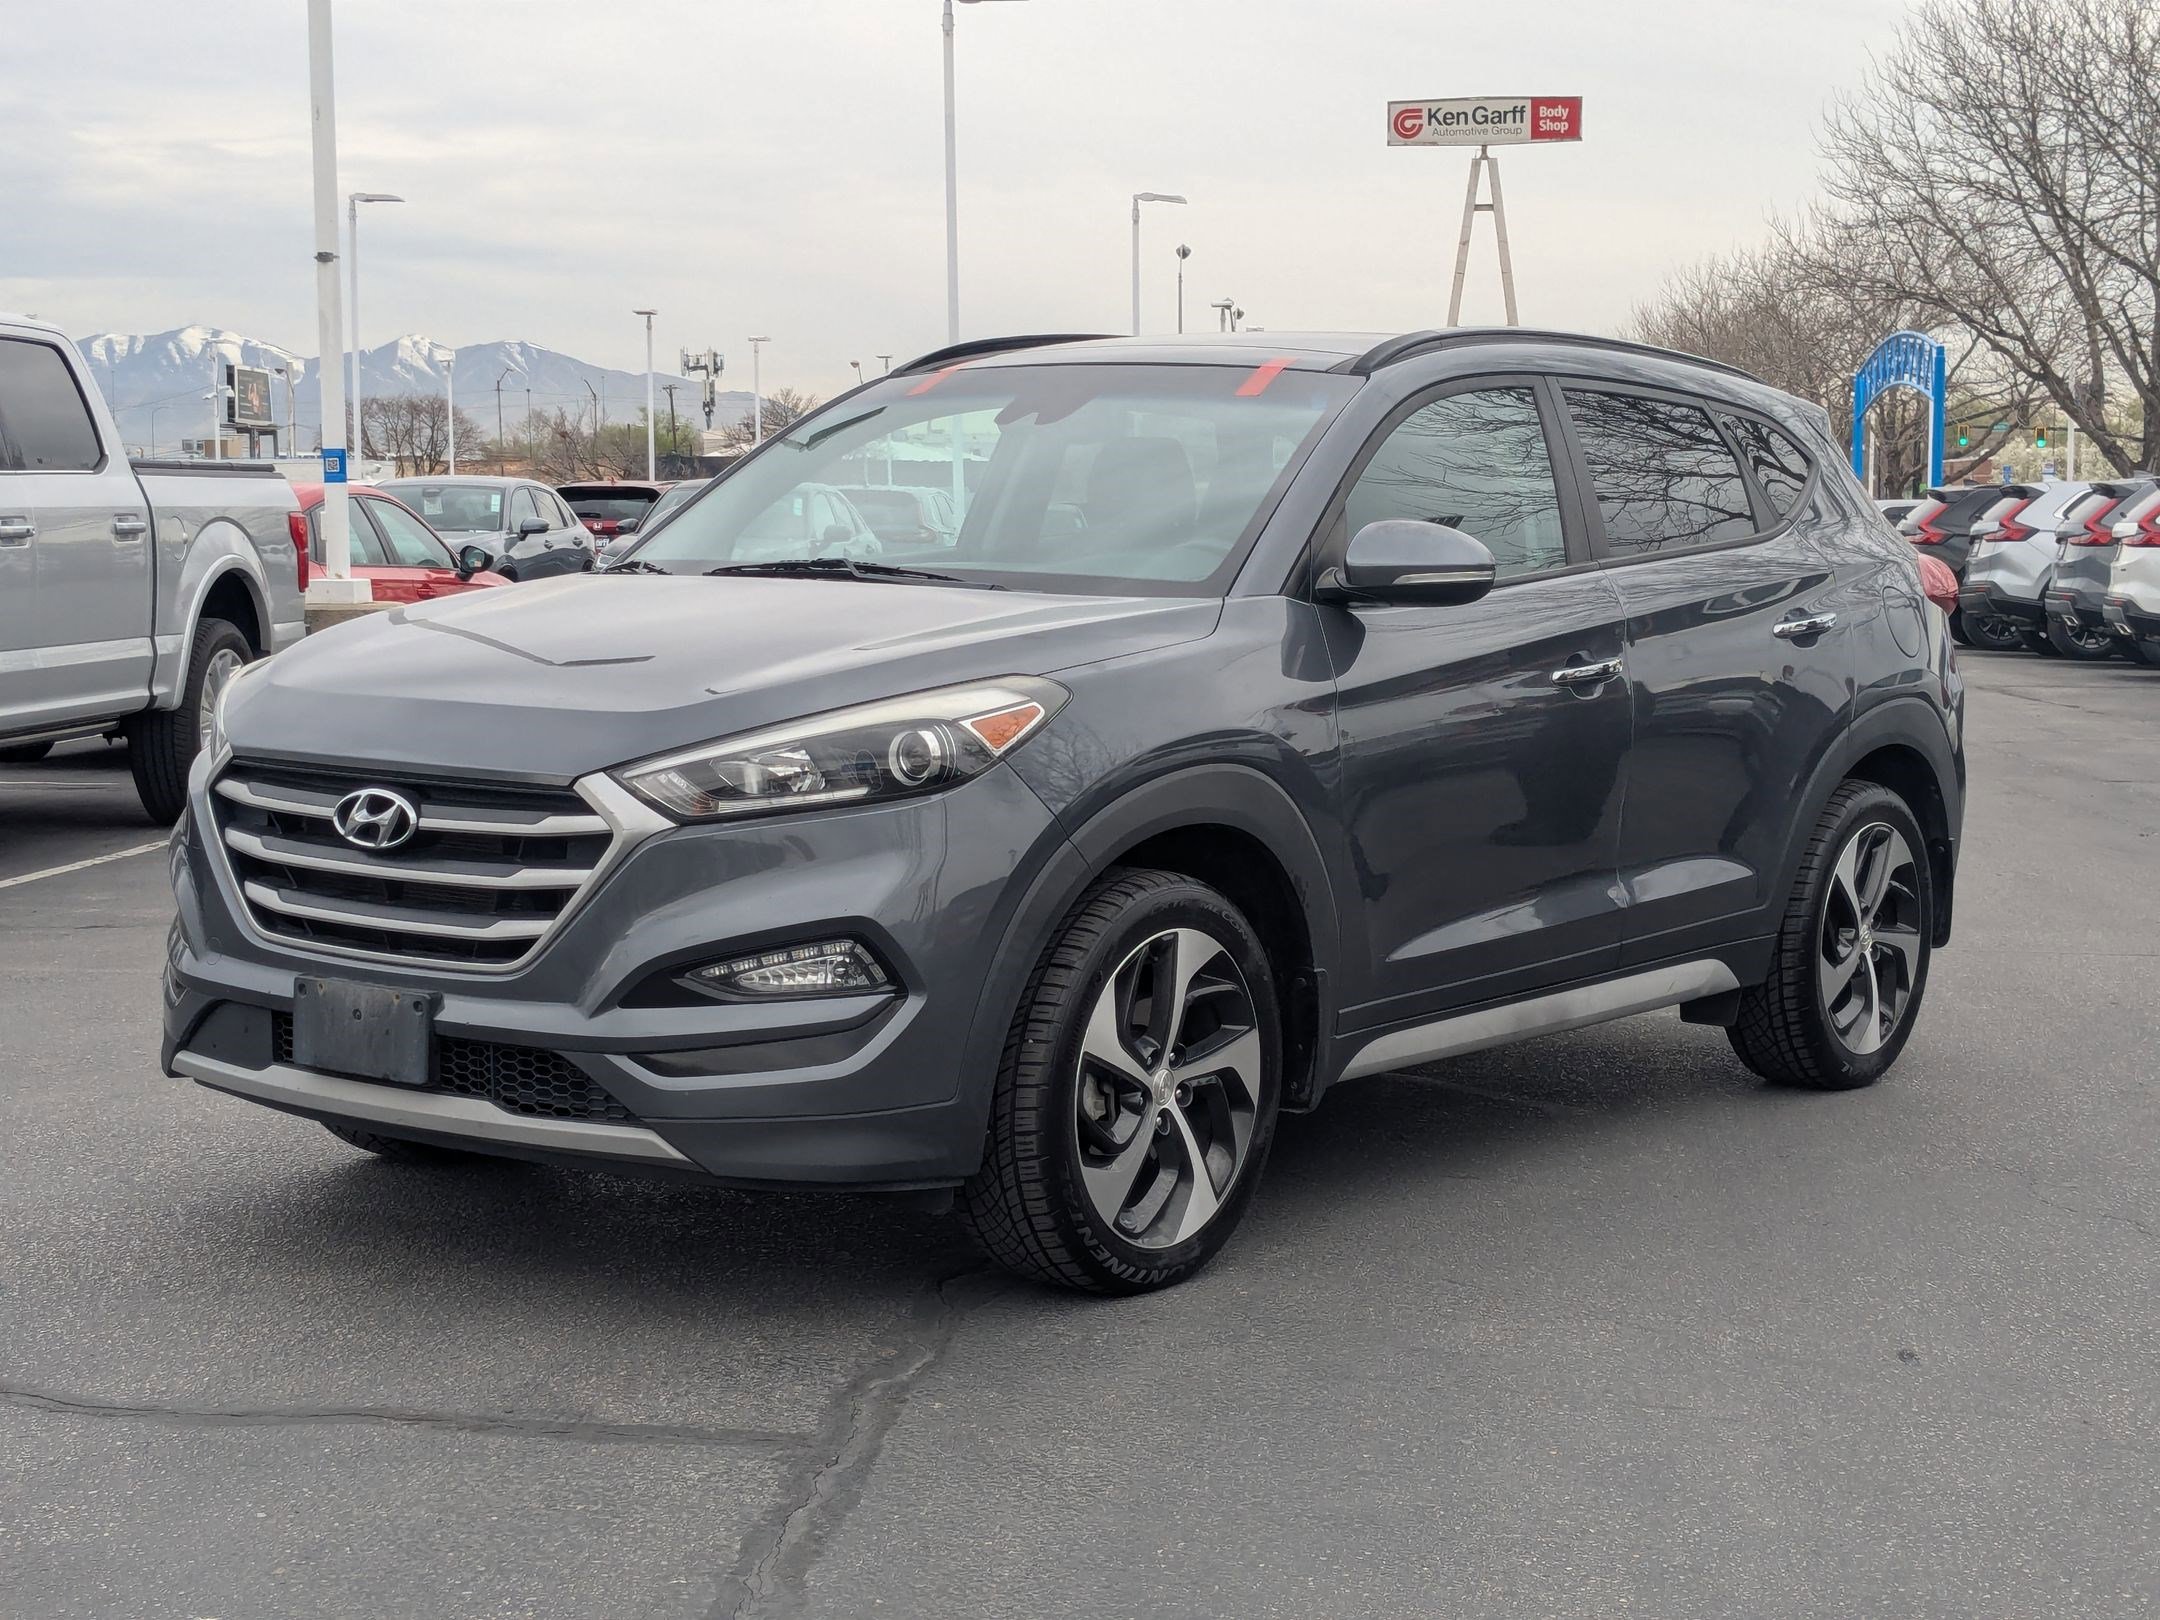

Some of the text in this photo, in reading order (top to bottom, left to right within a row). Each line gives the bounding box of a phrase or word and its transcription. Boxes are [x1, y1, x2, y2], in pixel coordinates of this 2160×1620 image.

[1427, 105, 1526, 126] Ken Garff
[1539, 105, 1569, 120] Body
[1432, 126, 1523, 137] Automotive Group
[1539, 119, 1569, 134] Shop
